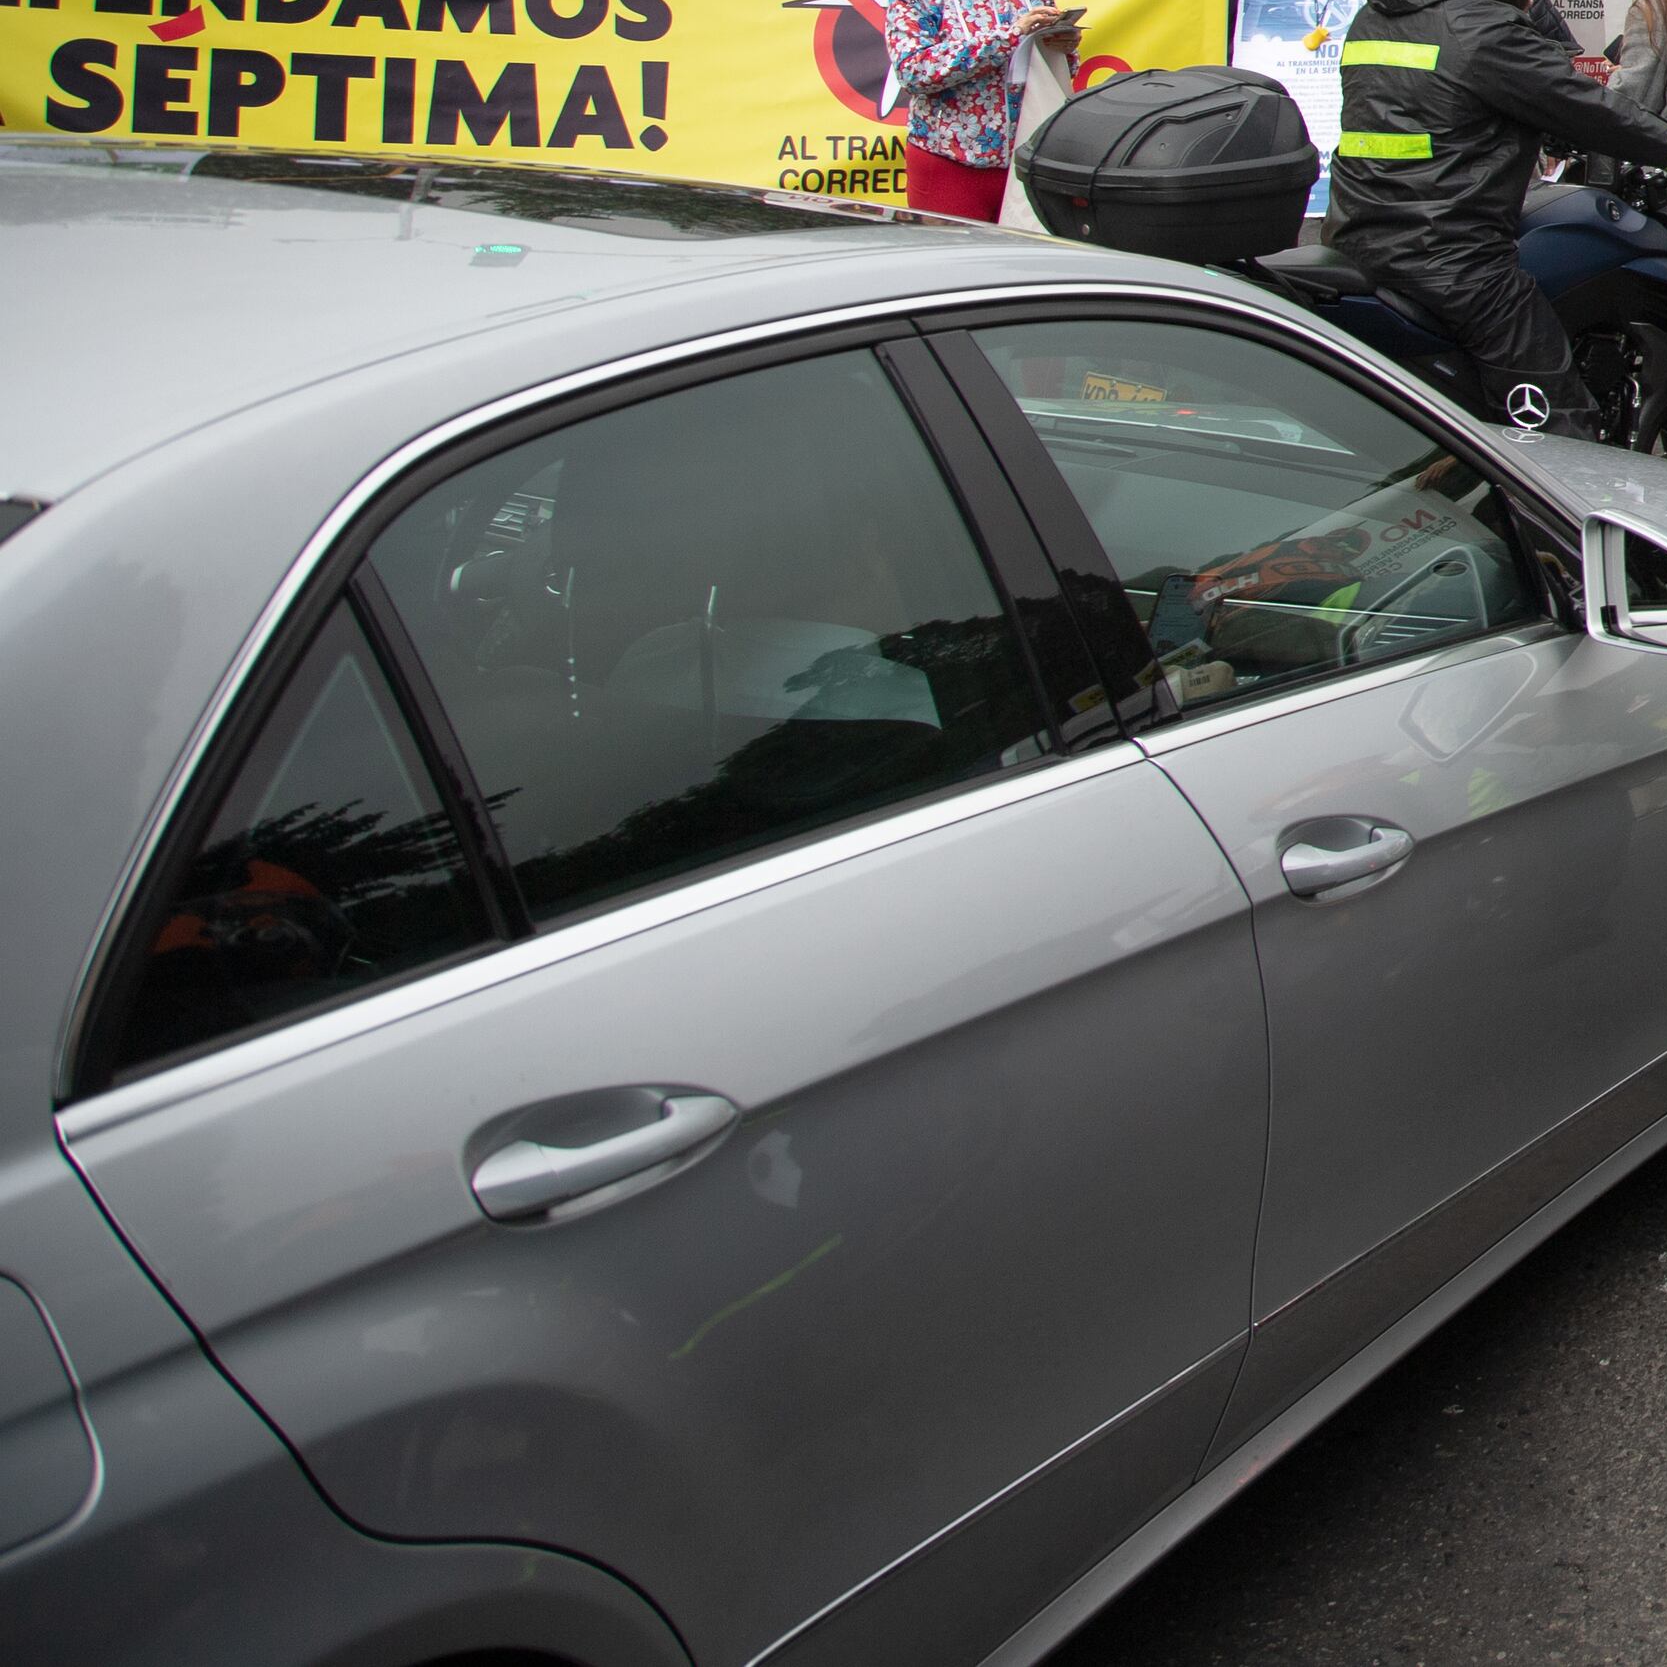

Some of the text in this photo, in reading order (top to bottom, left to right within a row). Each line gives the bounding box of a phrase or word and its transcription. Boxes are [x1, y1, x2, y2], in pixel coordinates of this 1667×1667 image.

[1553, 0, 1564, 8] AL
[1315, 44, 1339, 59] NO
[46, 5, 670, 152] SÉPTIMA!
[778, 135, 818, 161] AL
